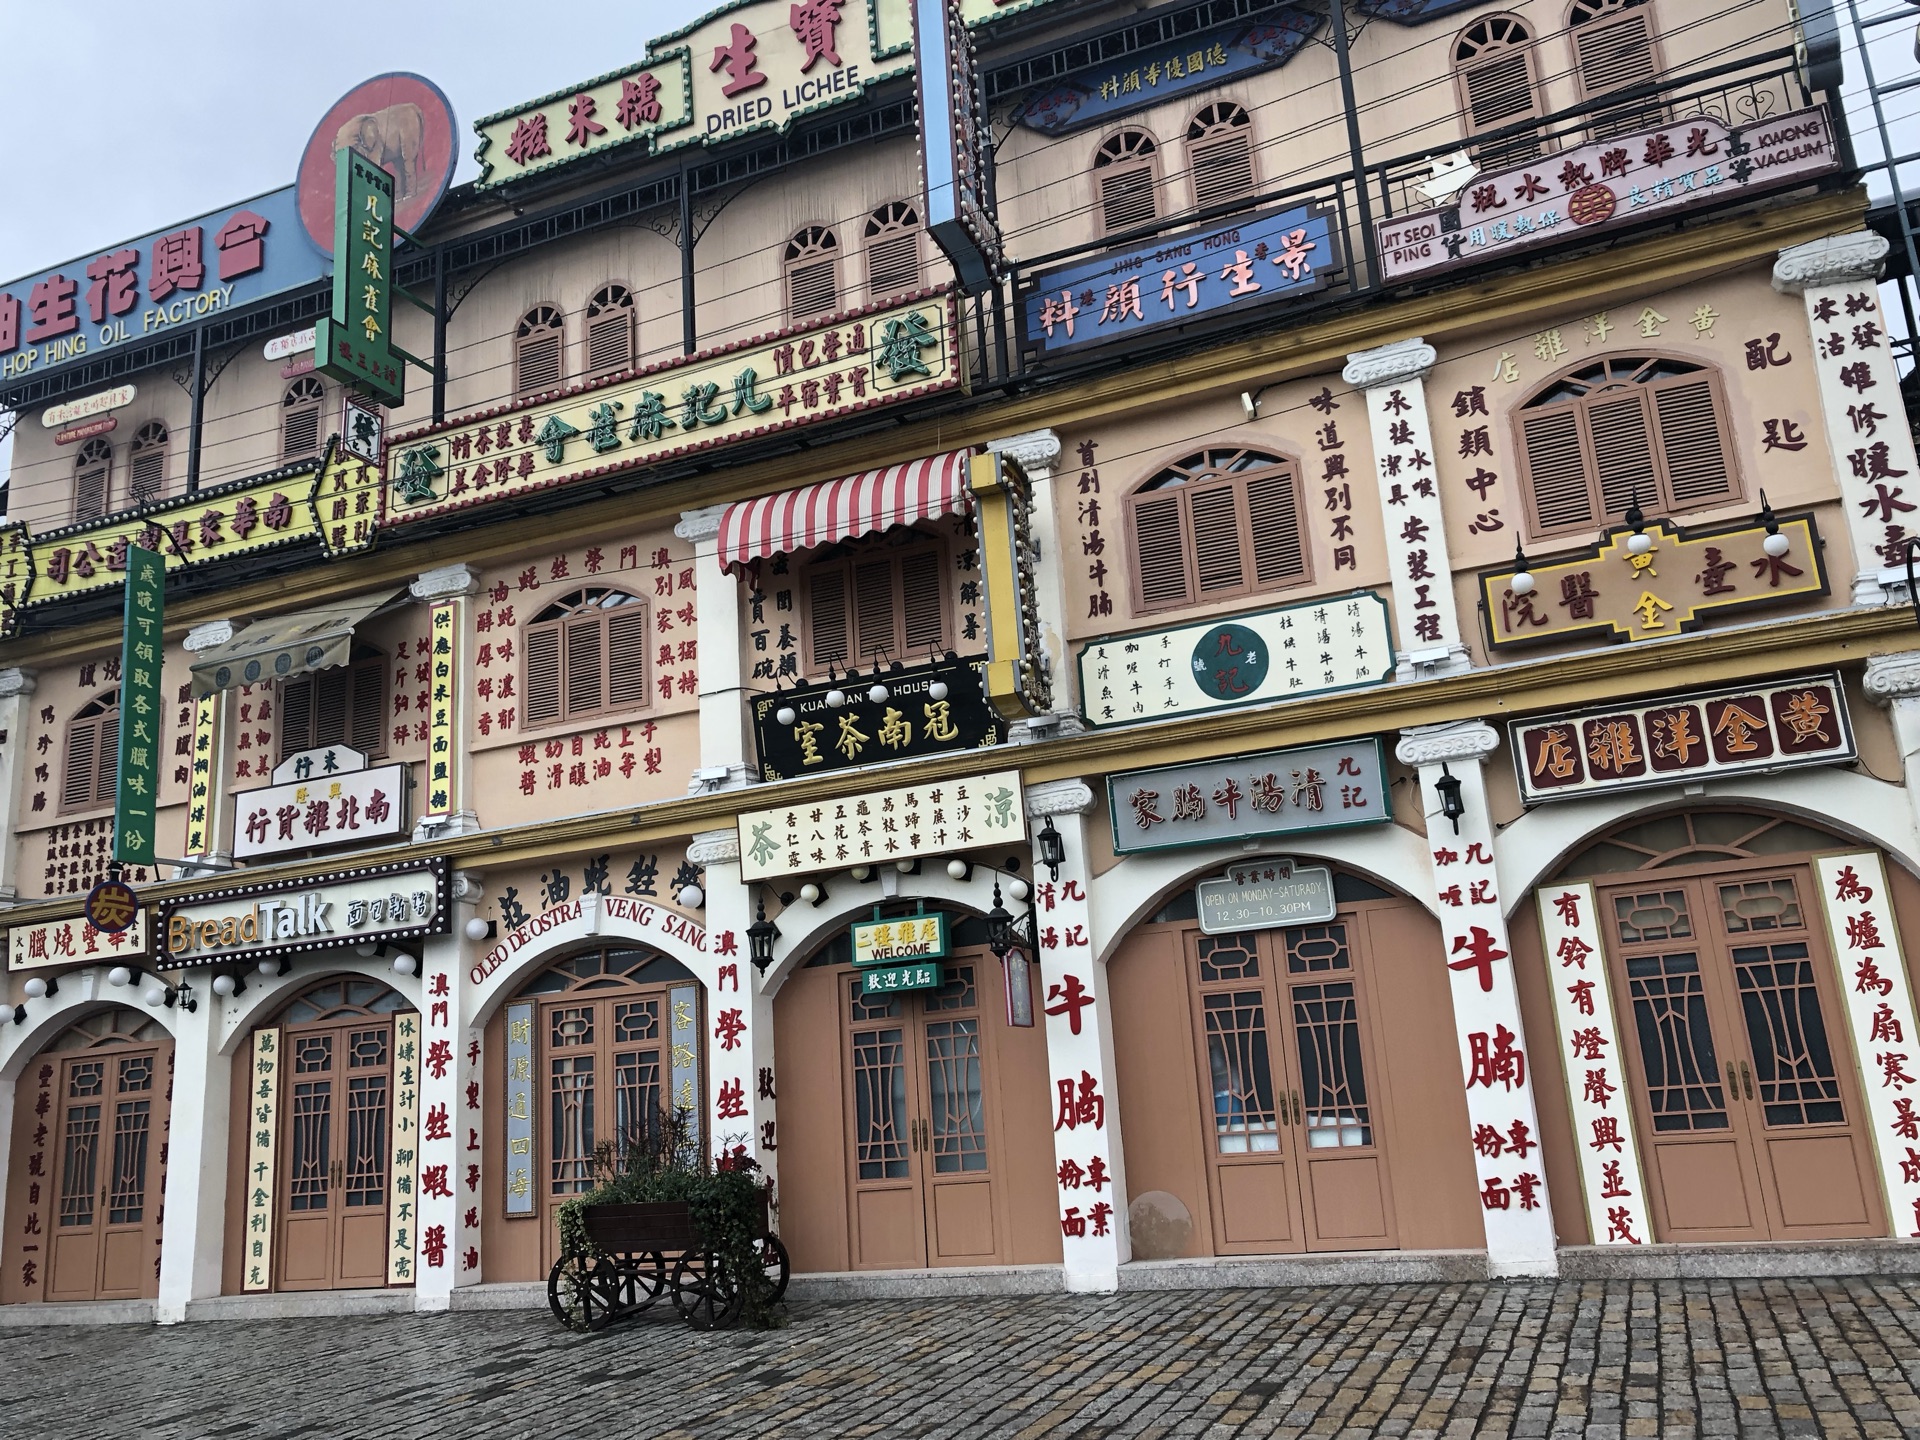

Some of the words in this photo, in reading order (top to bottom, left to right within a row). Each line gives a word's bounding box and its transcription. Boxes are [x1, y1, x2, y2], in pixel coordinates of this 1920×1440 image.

[706, 96, 772, 135] DRIED
[783, 65, 861, 109] LICHEE
[1758, 120, 1820, 149] KWONG
[1754, 140, 1824, 169] VACUUM
[1203, 229, 1242, 251] HONG
[1384, 231, 1401, 249] JIT
[1404, 223, 1436, 244] SEOI
[1393, 244, 1432, 265] PING
[2, 351, 38, 377] HOP
[44, 333, 88, 365] HING
[99, 319, 131, 346] OIL
[143, 284, 236, 333] FACTORY
[294, 749, 340, 780] 米行
[245, 788, 390, 844] 南北雜貨行
[956, 785, 974, 843] 豆沙冰
[1233, 865, 1293, 886] 營業時間
[1205, 893, 1226, 908] OPEN
[1227, 891, 1241, 904] ON
[168, 892, 335, 953] BreadTalk
[470, 943, 509, 986] OLEO
[506, 925, 532, 953] DE
[530, 900, 582, 937] OSTRA
[605, 898, 655, 927] VENG
[661, 914, 707, 952] SANG
[871, 942, 931, 961] WELCOME
